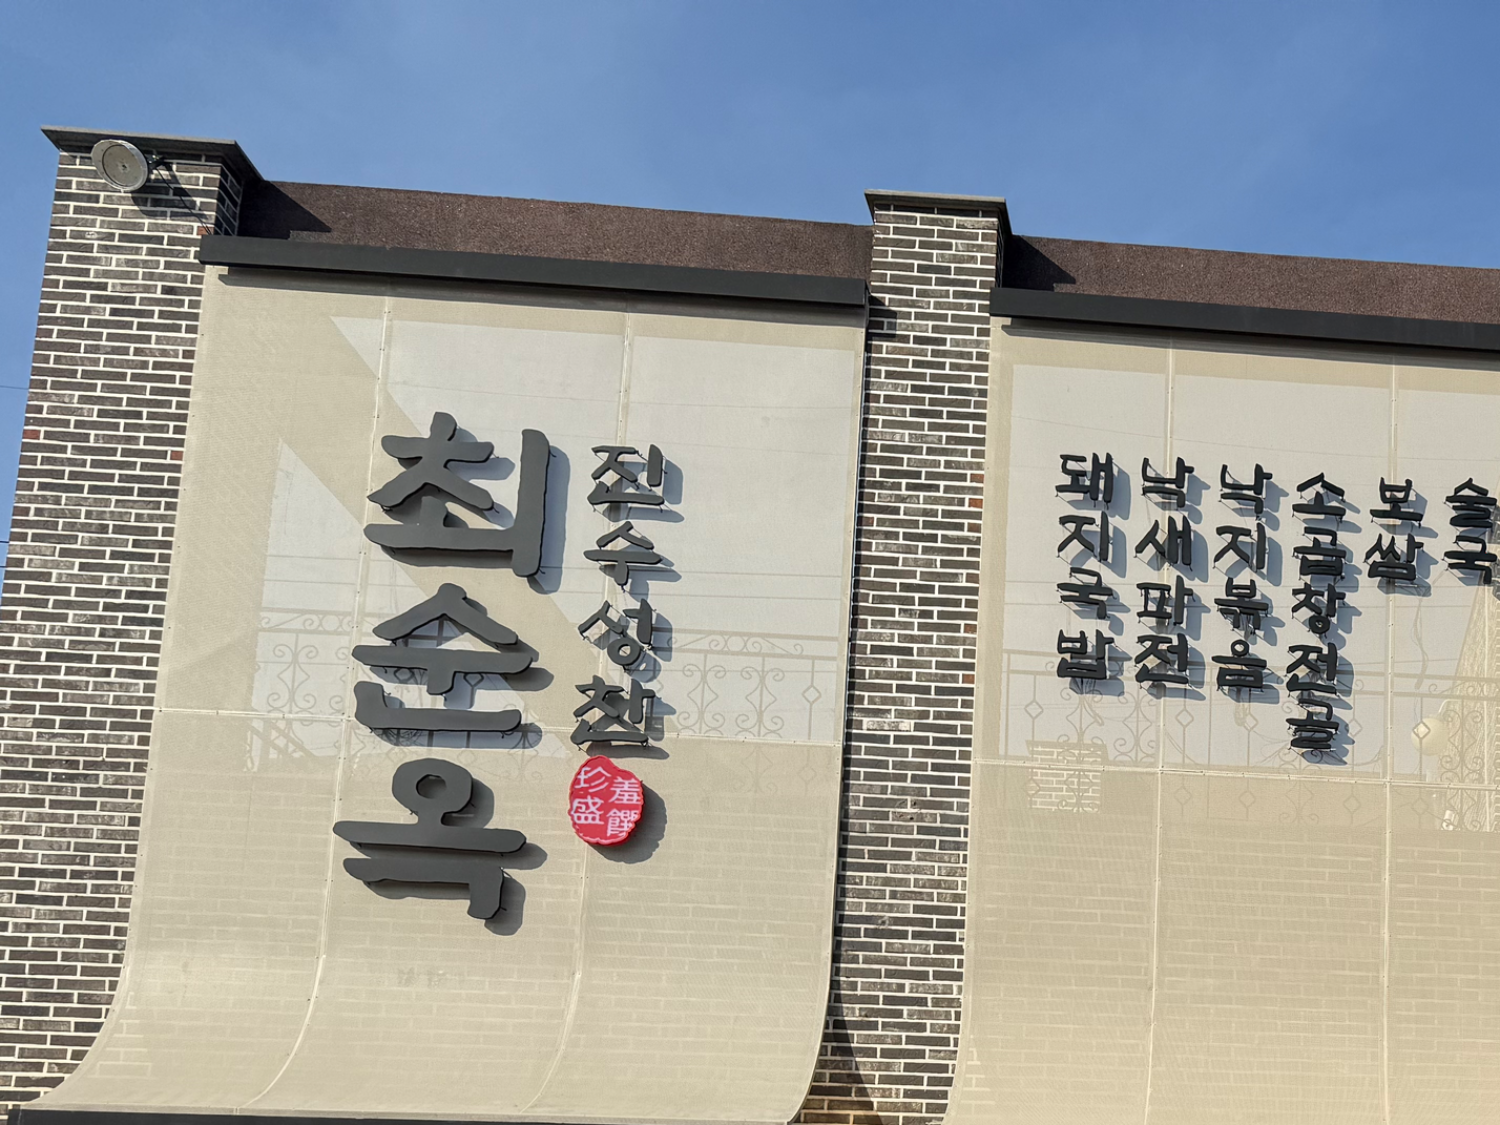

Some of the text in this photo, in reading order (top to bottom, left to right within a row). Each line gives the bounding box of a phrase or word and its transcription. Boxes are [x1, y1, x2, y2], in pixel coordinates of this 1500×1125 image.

[570, 443, 666, 747] 진수성찬
[1055, 452, 1114, 680] 돼지국밥
[1134, 456, 1194, 686] 낙새파전
[1212, 463, 1272, 690] 낙지볶음
[1286, 472, 1347, 751] 소곱창전골
[1364, 477, 1424, 582] 보쌈
[1442, 477, 1498, 585] 술국
[333, 411, 551, 920] 최순옥
